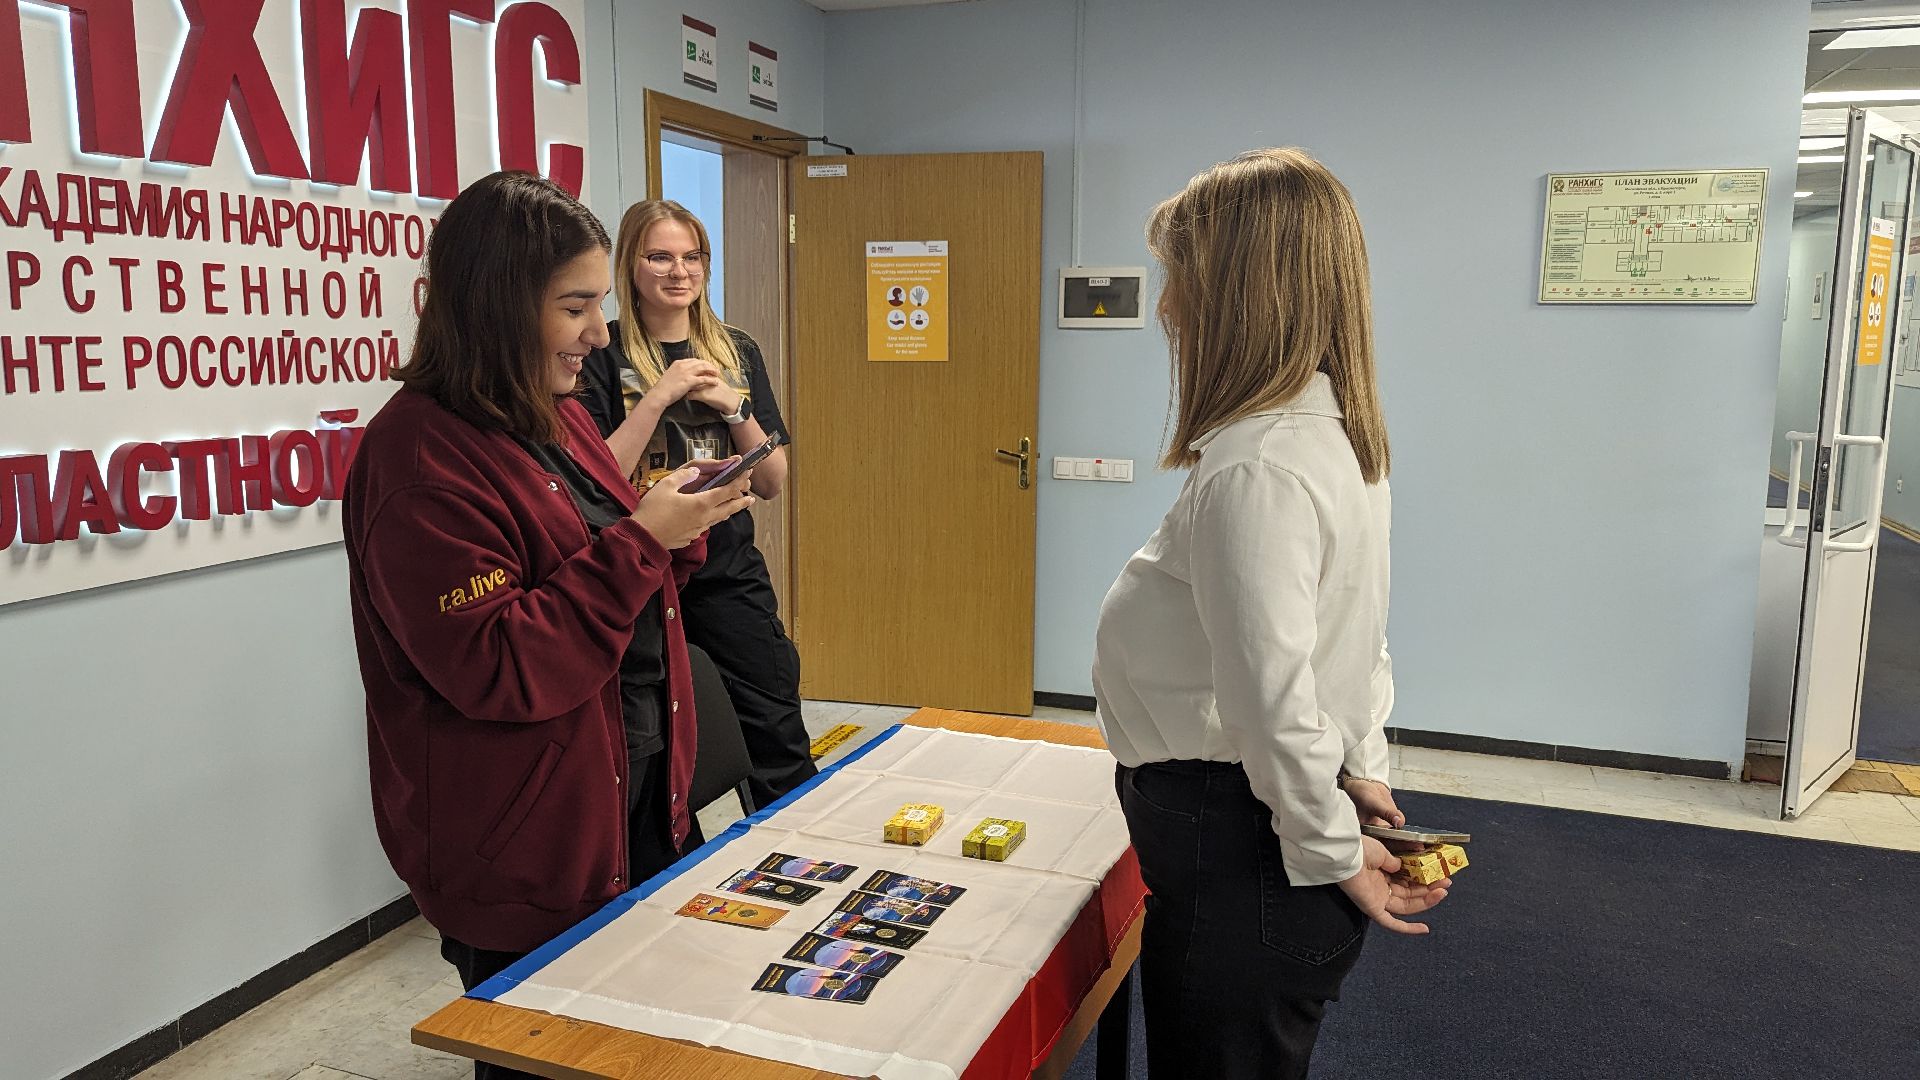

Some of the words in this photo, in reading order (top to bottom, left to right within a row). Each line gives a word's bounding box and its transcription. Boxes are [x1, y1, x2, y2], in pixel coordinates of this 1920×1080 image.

[1568, 178, 1604, 187] РАНХиГС
[1614, 178, 1641, 186] ПЛАН
[1642, 177, 1698, 186] ЭВАКУАЦИИ
[220, 192, 426, 263] НАРОДНОГО
[7, 250, 383, 319] РСТВЕННОЙ
[1, 335, 106, 394] НТЕ
[122, 329, 400, 390] РОССИЙСКОЙ
[439, 568, 506, 613] r.a.live
